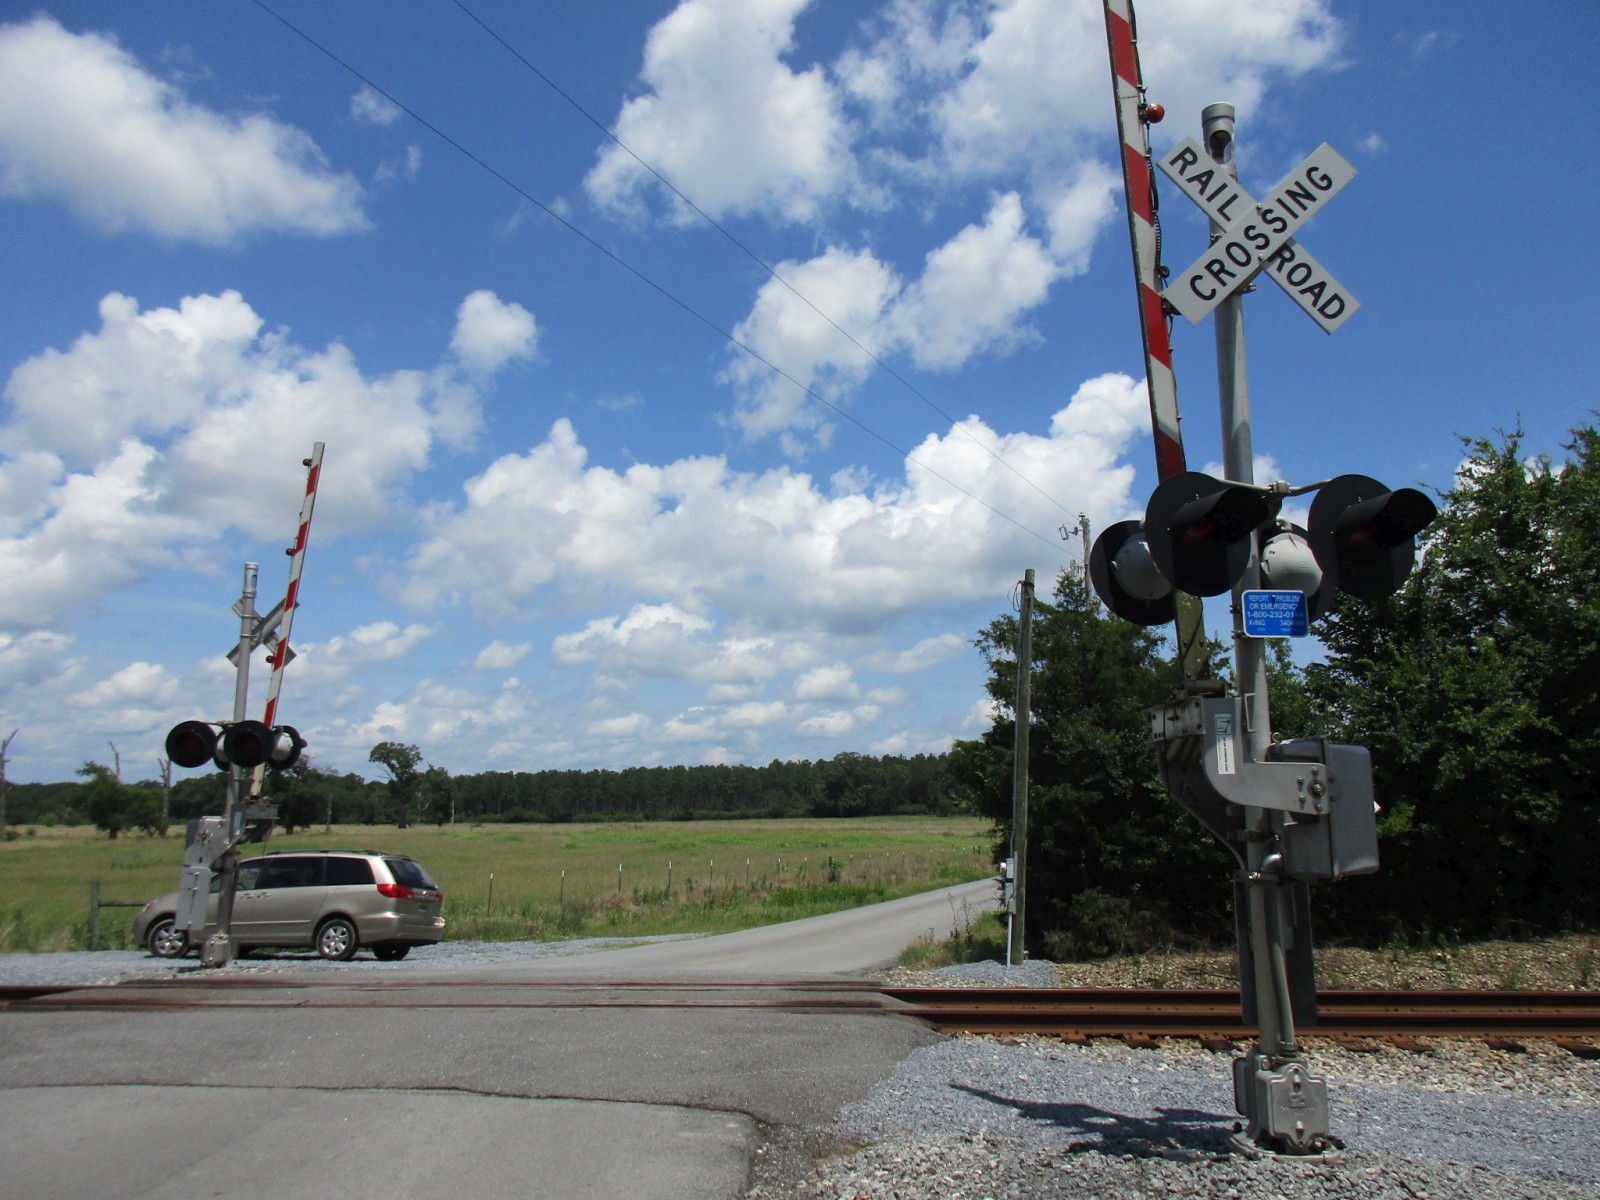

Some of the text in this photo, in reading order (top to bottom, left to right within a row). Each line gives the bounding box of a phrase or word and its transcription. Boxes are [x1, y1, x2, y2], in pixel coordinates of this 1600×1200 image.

[1169, 146, 1239, 222] RAIL
[1189, 166, 1333, 301] CROSSING
[1266, 243, 1345, 320] ROAD
